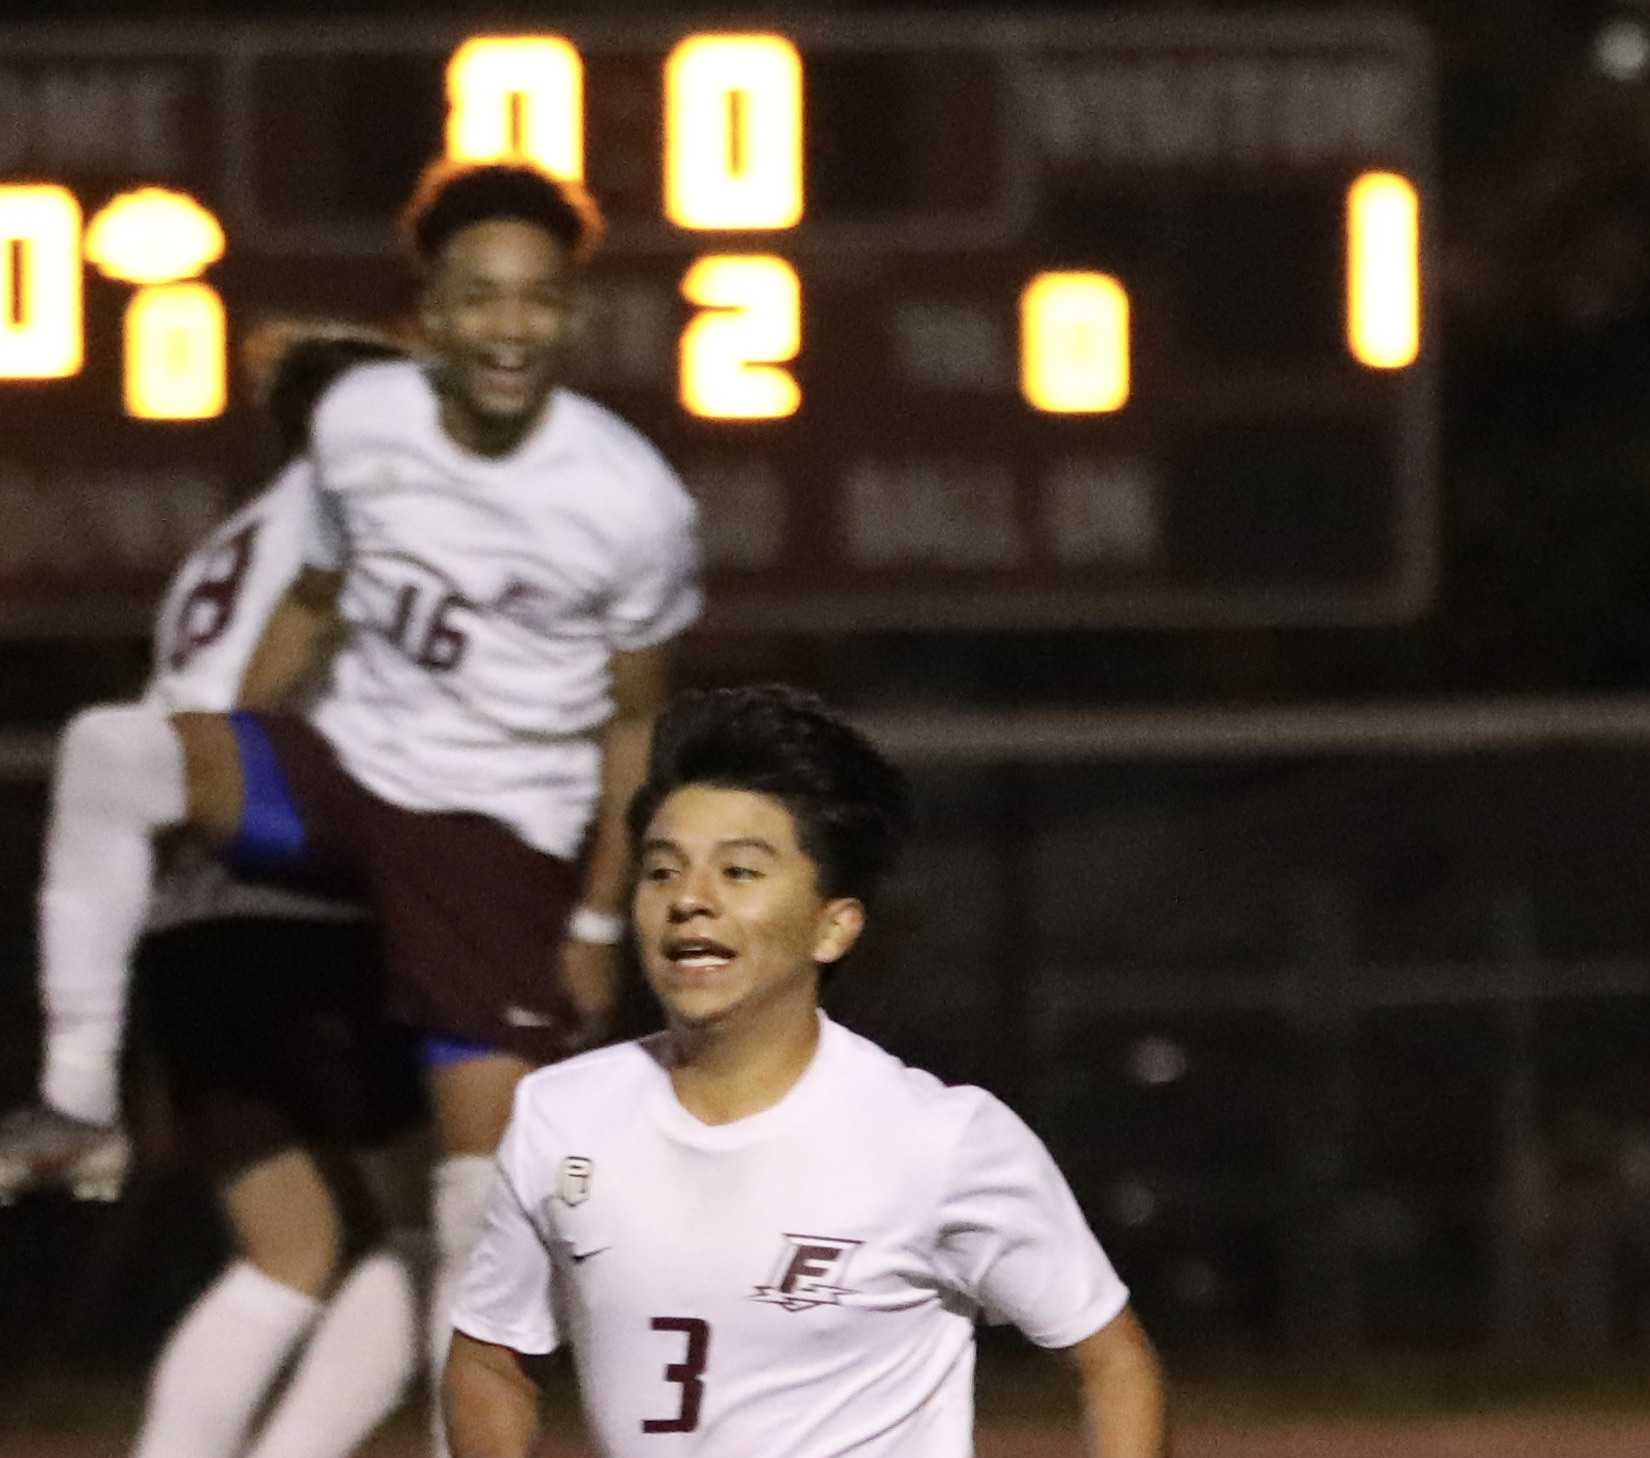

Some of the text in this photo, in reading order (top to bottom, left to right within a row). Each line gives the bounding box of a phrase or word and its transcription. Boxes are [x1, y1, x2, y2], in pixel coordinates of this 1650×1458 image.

[663, 32, 803, 231] 0
[680, 252, 801, 420] 2
[1344, 170, 1421, 369] 1
[641, 1316, 711, 1434] 3
